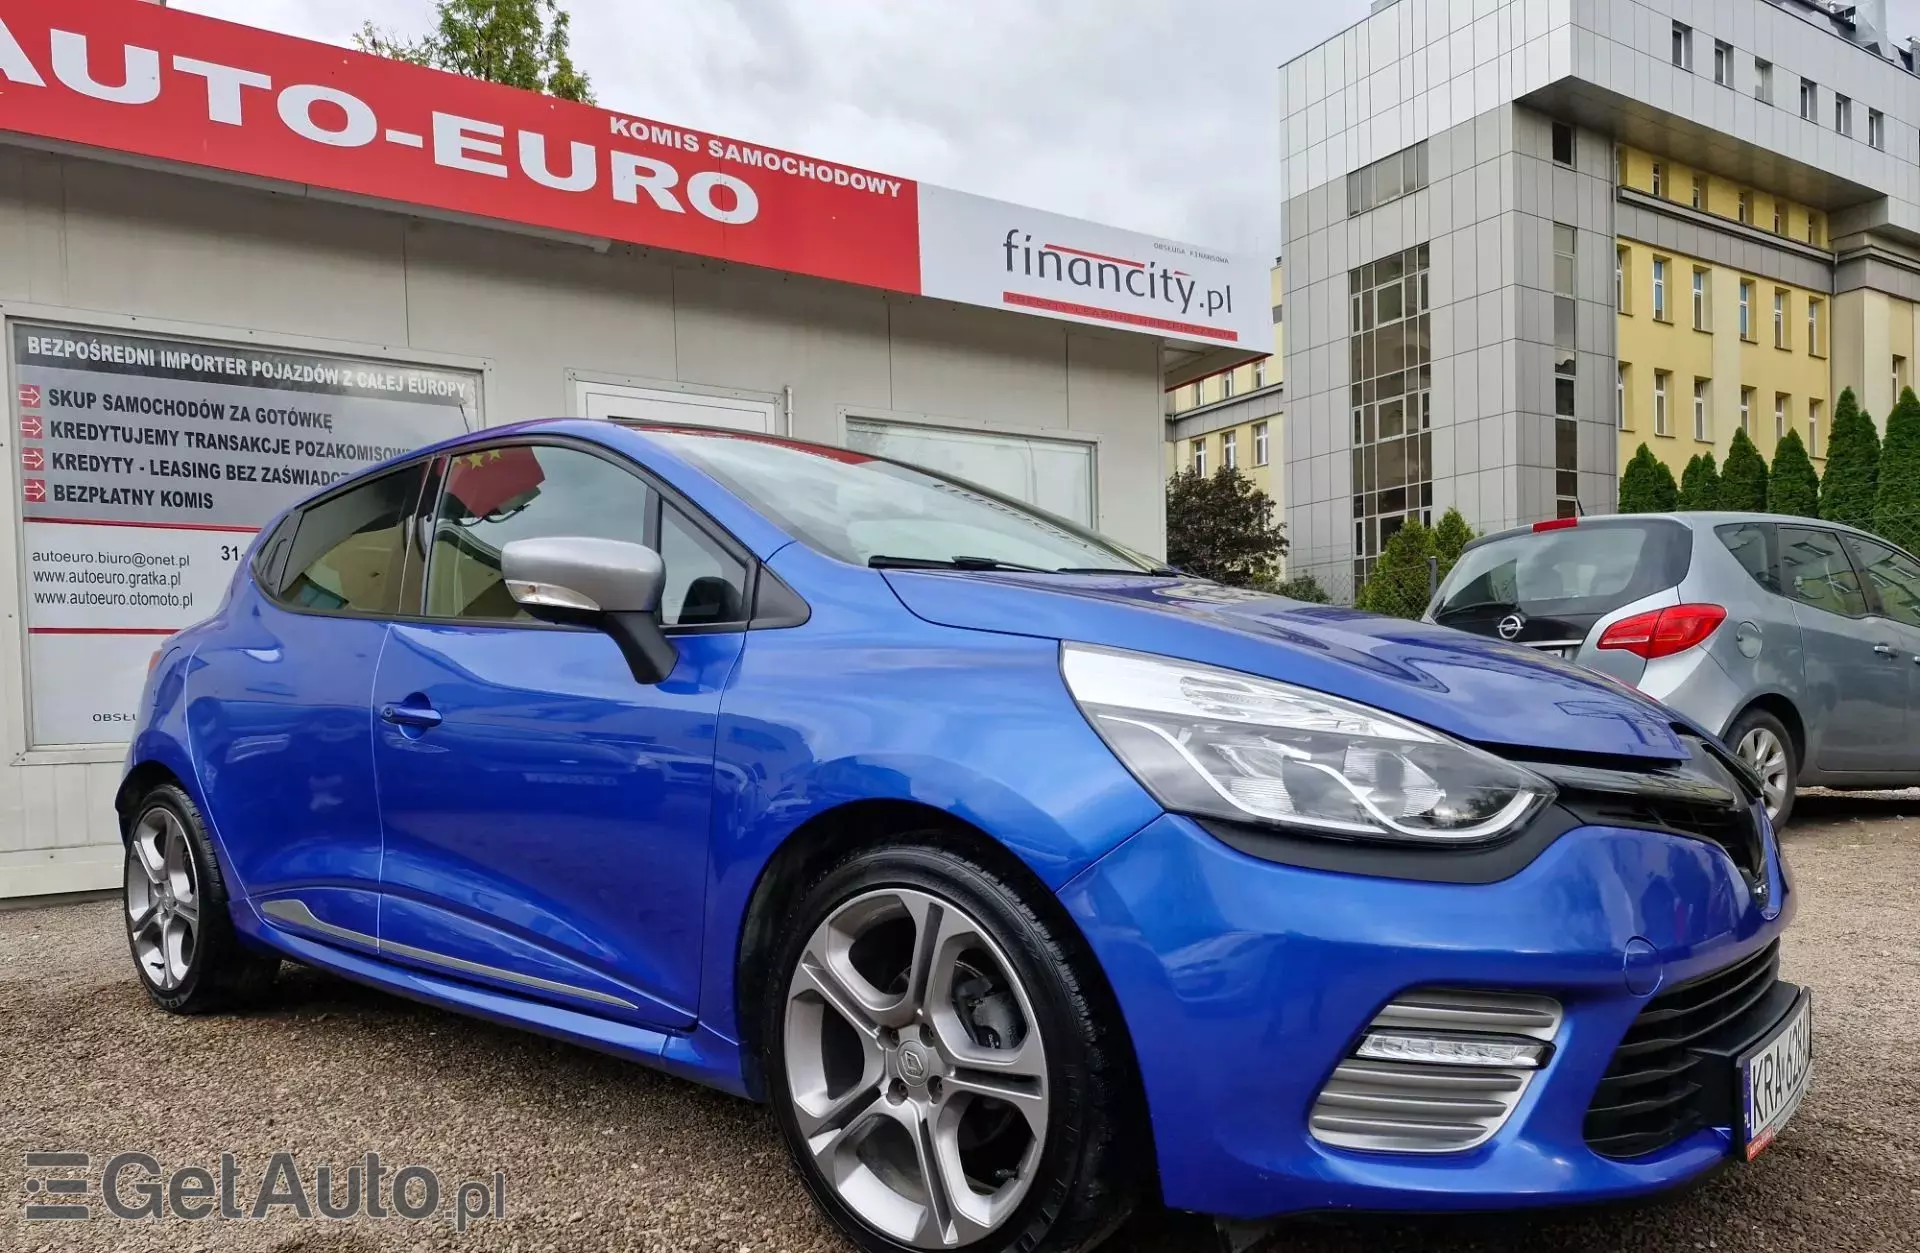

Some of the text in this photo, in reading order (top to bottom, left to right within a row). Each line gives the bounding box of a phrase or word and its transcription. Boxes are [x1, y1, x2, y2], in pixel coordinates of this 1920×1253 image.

[610, 115, 902, 198] KOMIS SAMOCHODOWY
[1003, 228, 1232, 317] financity.pl
[27, 336, 466, 398] BEZPOŚREDNI IMPORTER POJAZDÓW Z CAŁEJ EUROPY
[48, 388, 333, 433] SKUP SAMOCHODÓW ZA GOTÓWKĘ
[50, 421, 409, 461] KREDYTUJEMY TRANSAKCJE POZAKOMISO
[52, 452, 134, 474] KREDYTY
[149, 459, 221, 480] LEASING
[226, 464, 257, 482] BEZ
[261, 465, 349, 486] ZAŚWIADC
[53, 484, 214, 510] BEZPŁATNY KOMIS
[32, 551, 190, 568] autoeuro.biuro@onet.pl
[33, 570, 181, 589] www.autoeuro.gratka.pl
[34, 592, 193, 609] www.autoeuro.otomoto.pl
[1753, 1044, 1783, 1130] KRA
